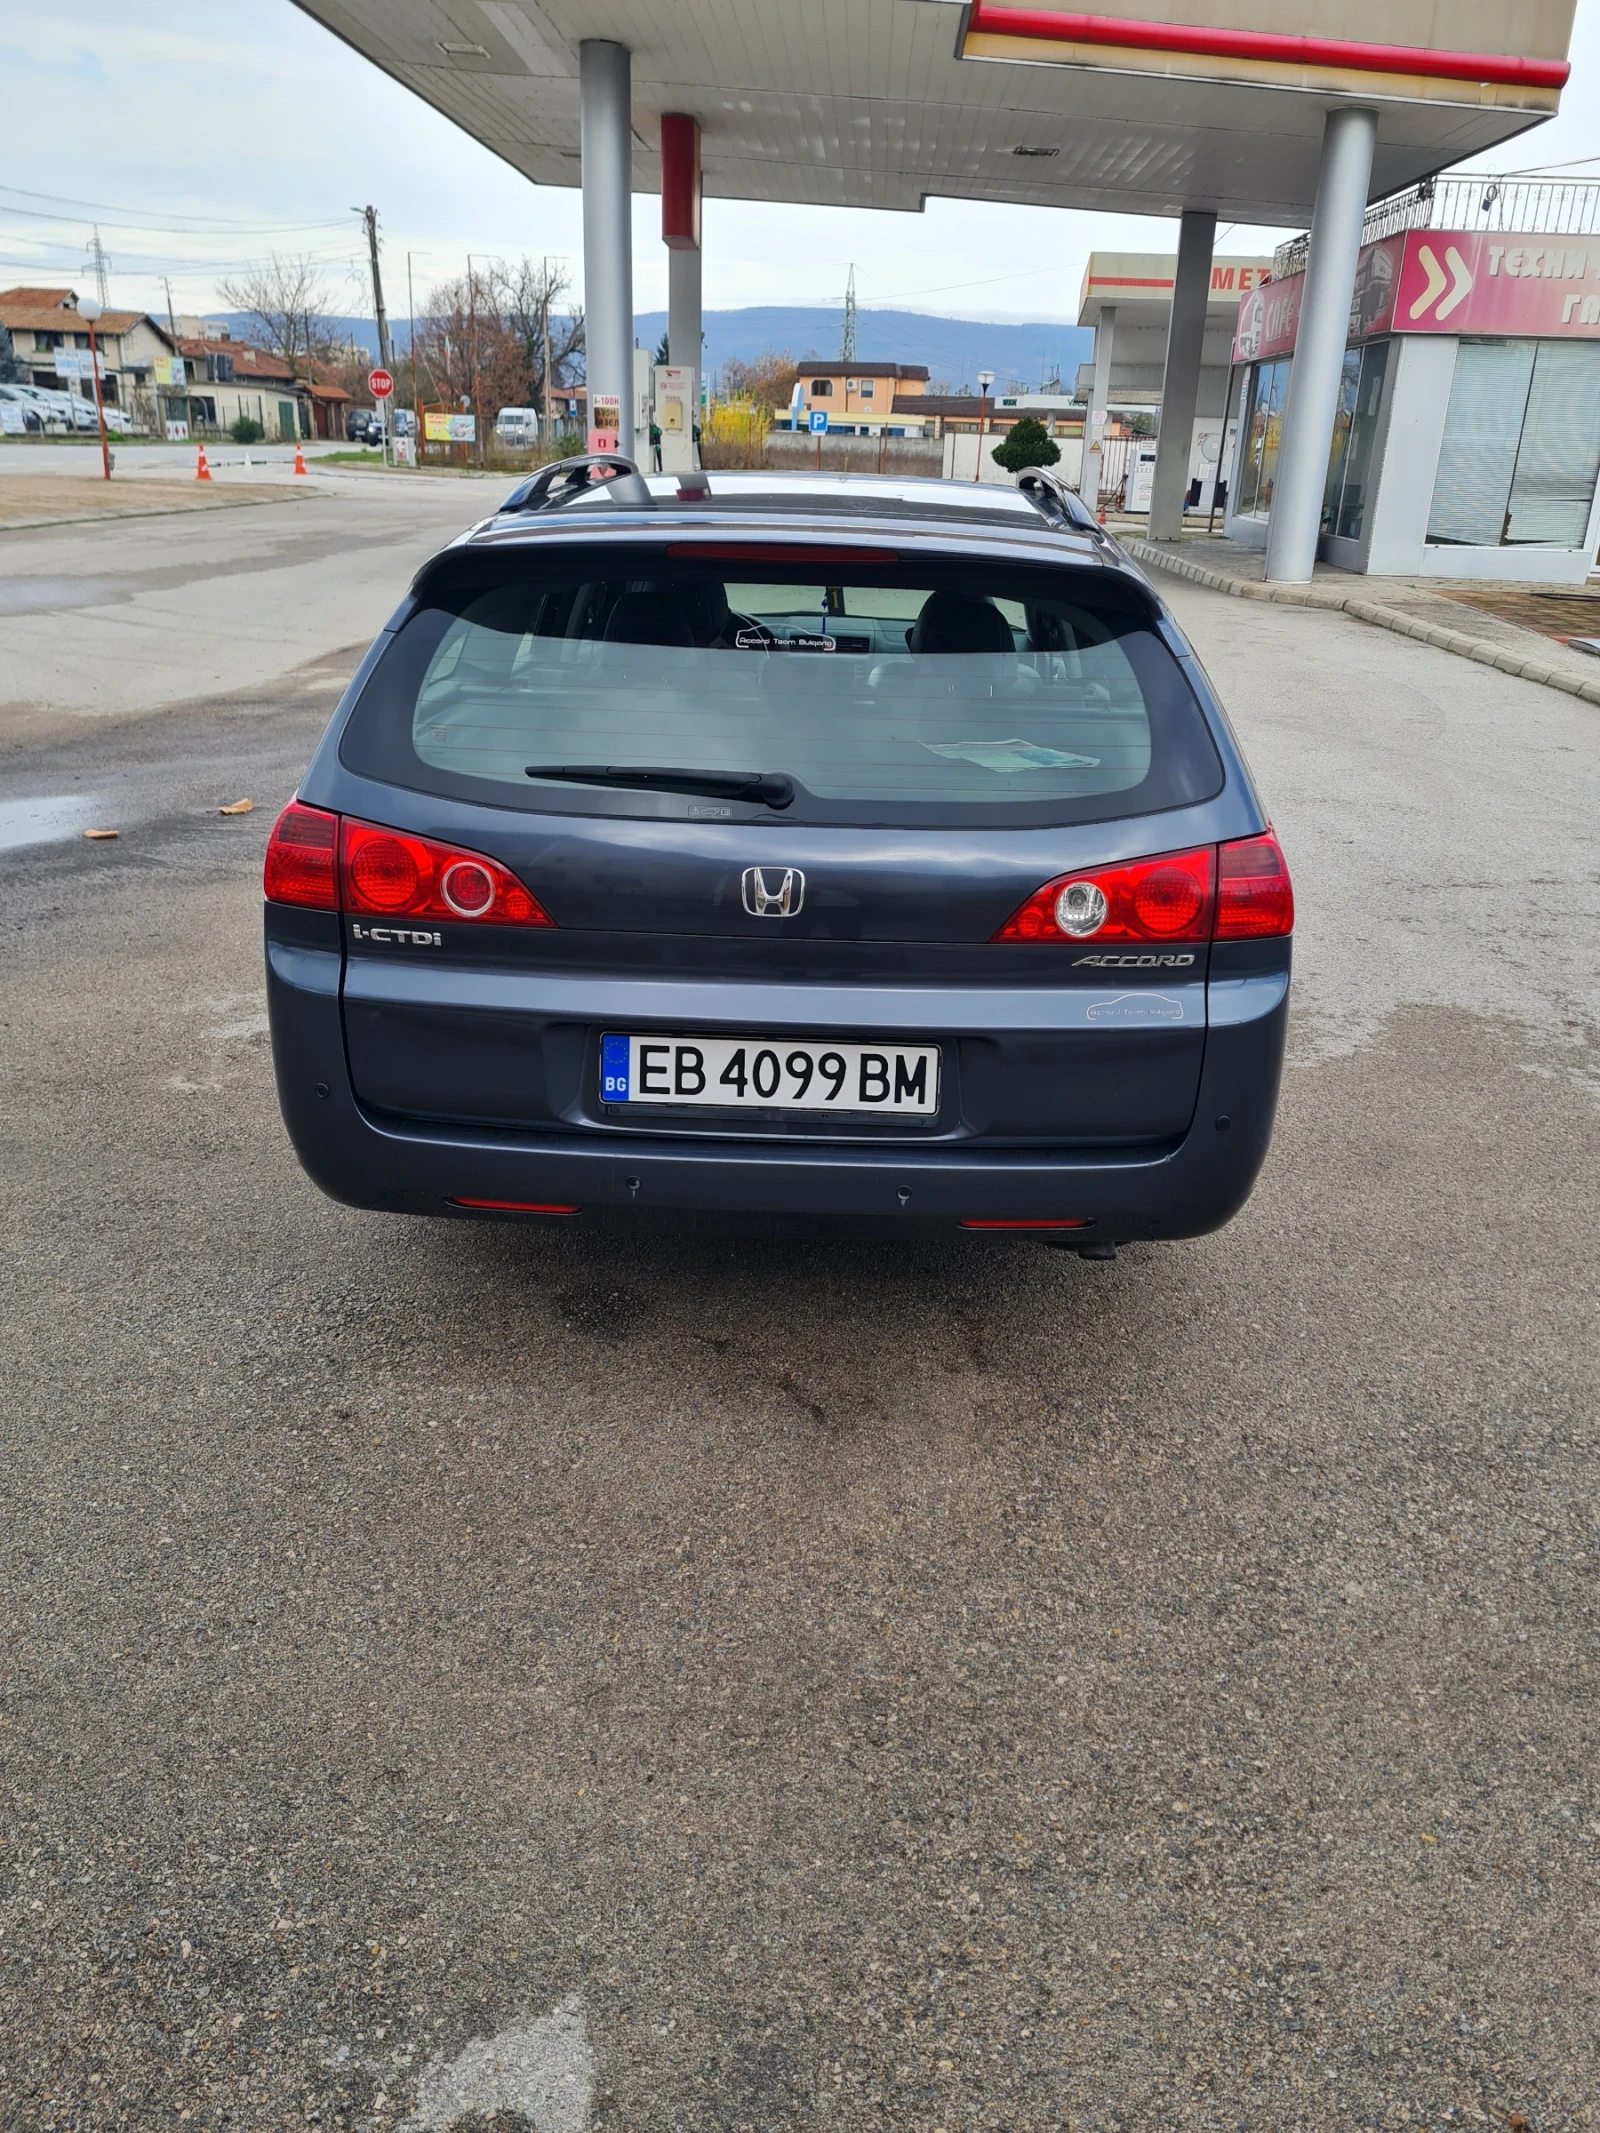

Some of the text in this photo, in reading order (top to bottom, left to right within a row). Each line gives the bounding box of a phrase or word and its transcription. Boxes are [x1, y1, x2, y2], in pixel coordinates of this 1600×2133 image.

[371, 377, 391, 389] STOP
[813, 413, 825, 429] P
[739, 637, 771, 645] Accord
[353, 923, 442, 946] i-CTDi
[1071, 954, 1195, 968] ACCORD
[639, 1044, 928, 1105] EB 4099 BM
[605, 1076, 627, 1091] BG
